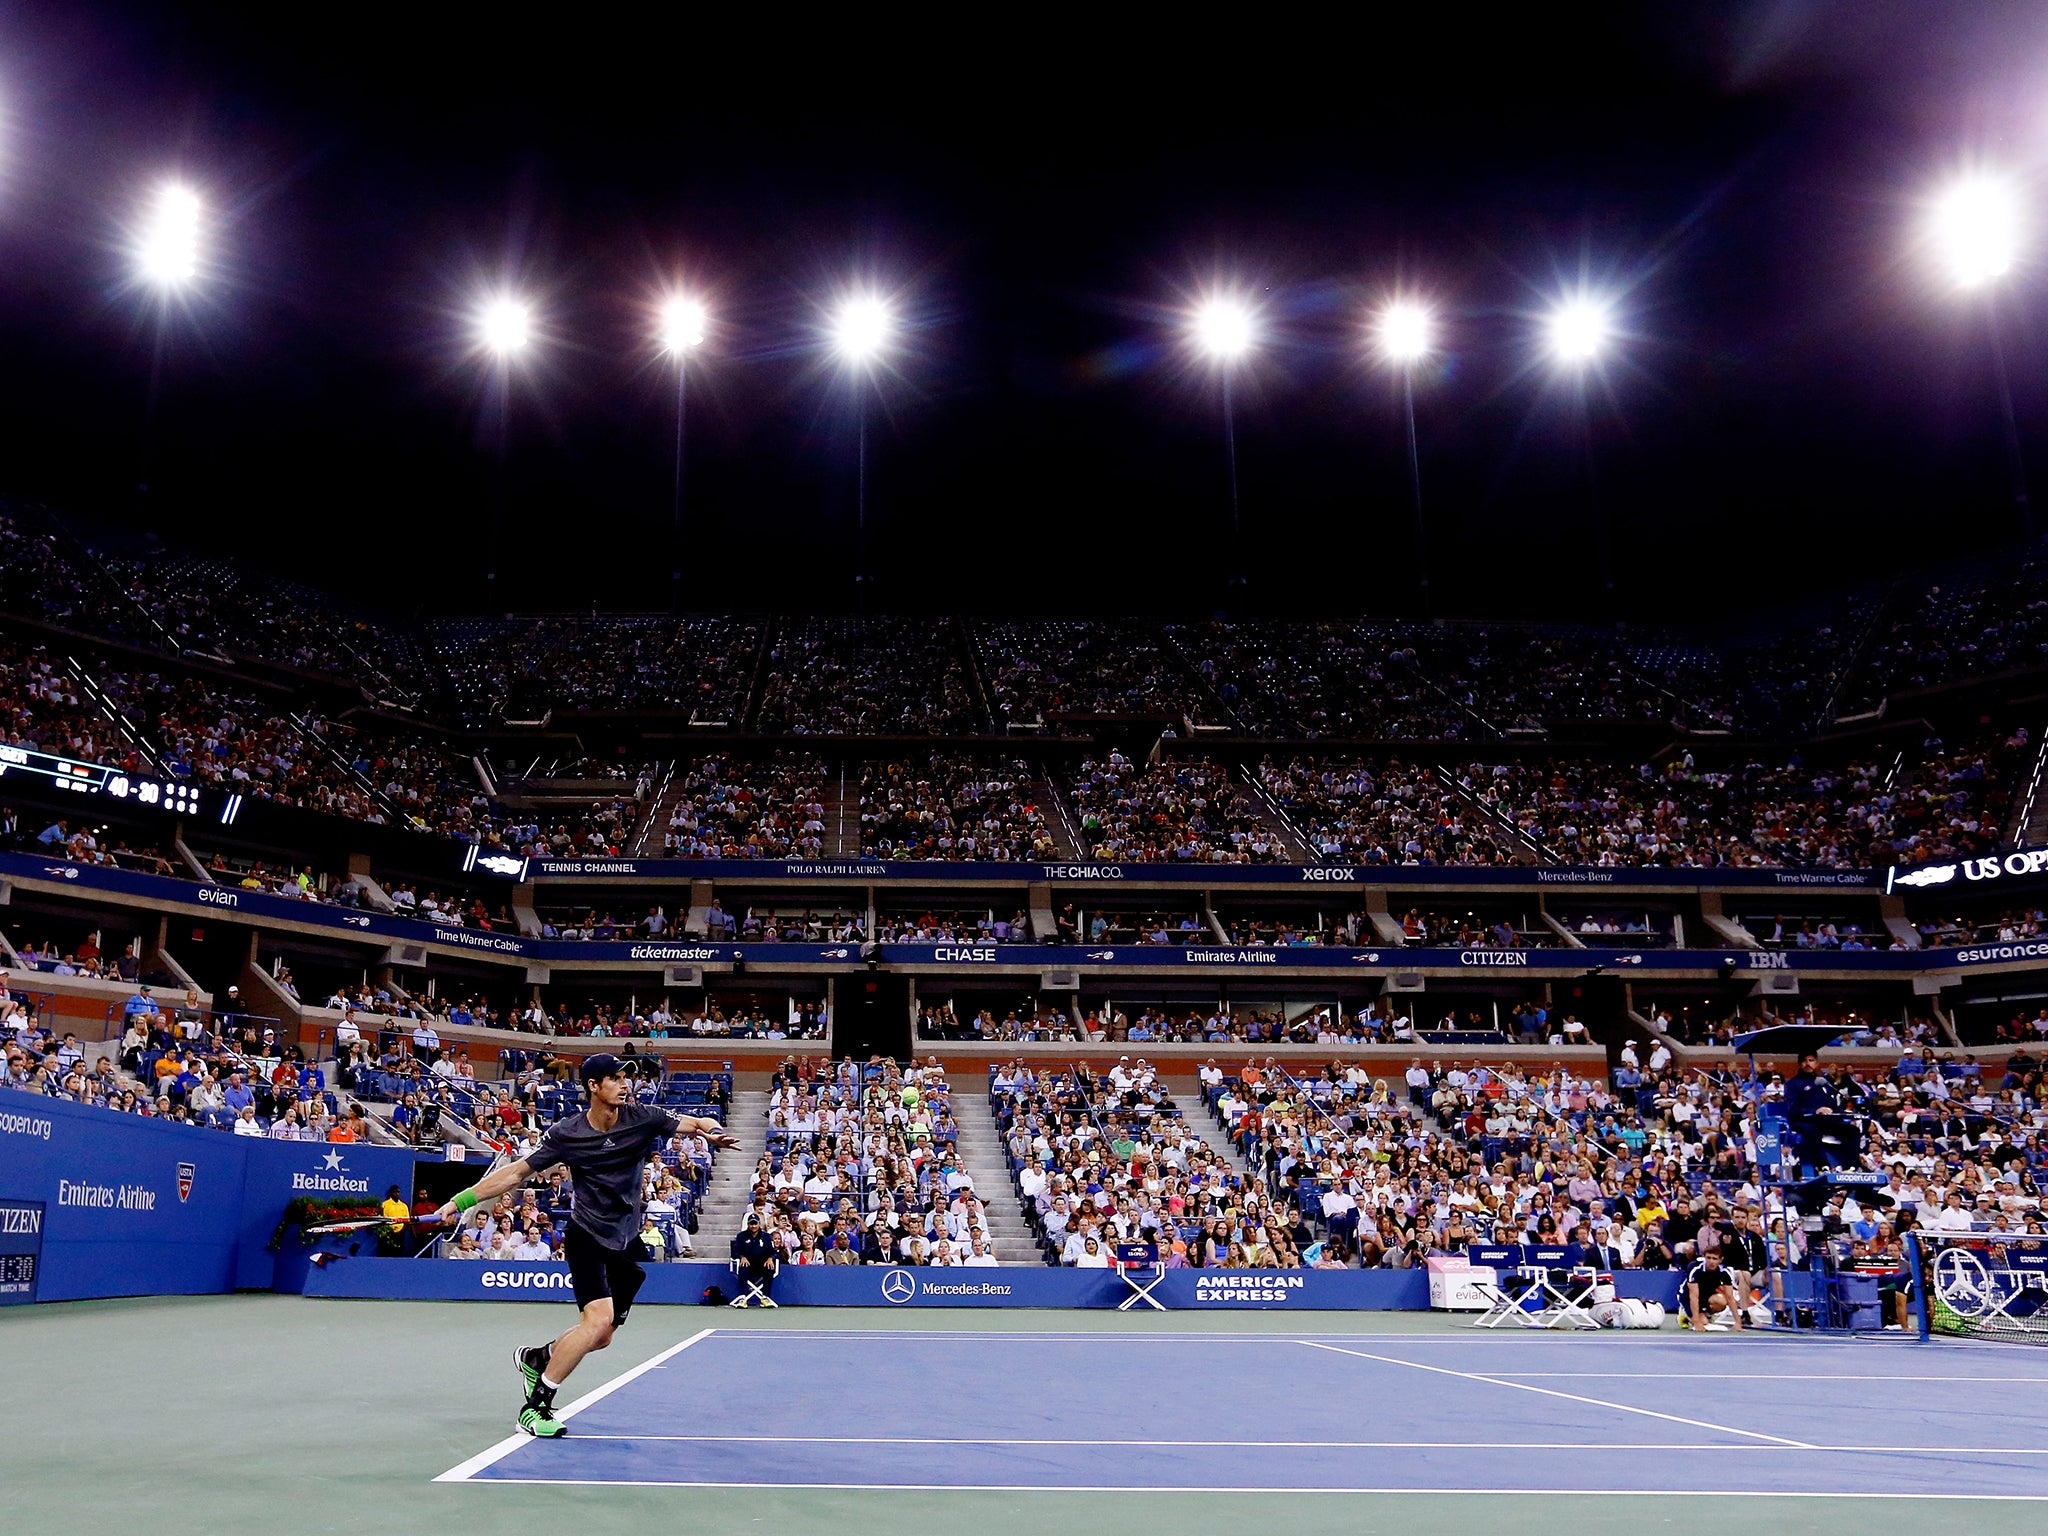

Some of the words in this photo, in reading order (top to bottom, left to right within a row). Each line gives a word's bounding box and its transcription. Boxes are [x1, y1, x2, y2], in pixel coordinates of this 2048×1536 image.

[542, 863, 582, 872] TENNIS
[584, 863, 637, 873] CHANNEL
[787, 866, 813, 874] POLO
[815, 866, 846, 874] RALPH
[848, 866, 886, 874] LAUREN
[1043, 866, 1067, 878] THE
[1068, 866, 1100, 878] CHIA
[1961, 856, 2001, 881] US
[2004, 849, 2048, 875] OP
[1302, 868, 1355, 880] xerox
[1537, 871, 1613, 881] Mercedes-Benz
[1775, 873, 1800, 883] Time
[1800, 873, 1836, 883] Warner
[1837, 873, 1865, 883] Cable
[198, 888, 238, 906] evian
[435, 928, 459, 942] Time
[459, 933, 494, 948] Warner
[494, 939, 520, 952] Cable
[630, 945, 715, 959] ticketmaster
[935, 948, 996, 962] CHASE
[1186, 950, 1236, 962] Emirates
[1238, 951, 1277, 963] Airline
[1460, 951, 1527, 965] CITIZEN
[1956, 943, 2048, 962] esurance
[1748, 952, 1788, 969] IBM
[292, 1173, 369, 1192] Heineken
[1835, 1174, 1878, 1183] usopen.org
[58, 1179, 115, 1208] Emirates
[116, 1184, 156, 1211] Airline
[481, 1271, 574, 1289] esuranc
[1196, 1276, 1304, 1288] AMERICAN
[922, 1282, 1012, 1296] Mercedes-Benz
[1196, 1290, 1287, 1301] EXPRESS
